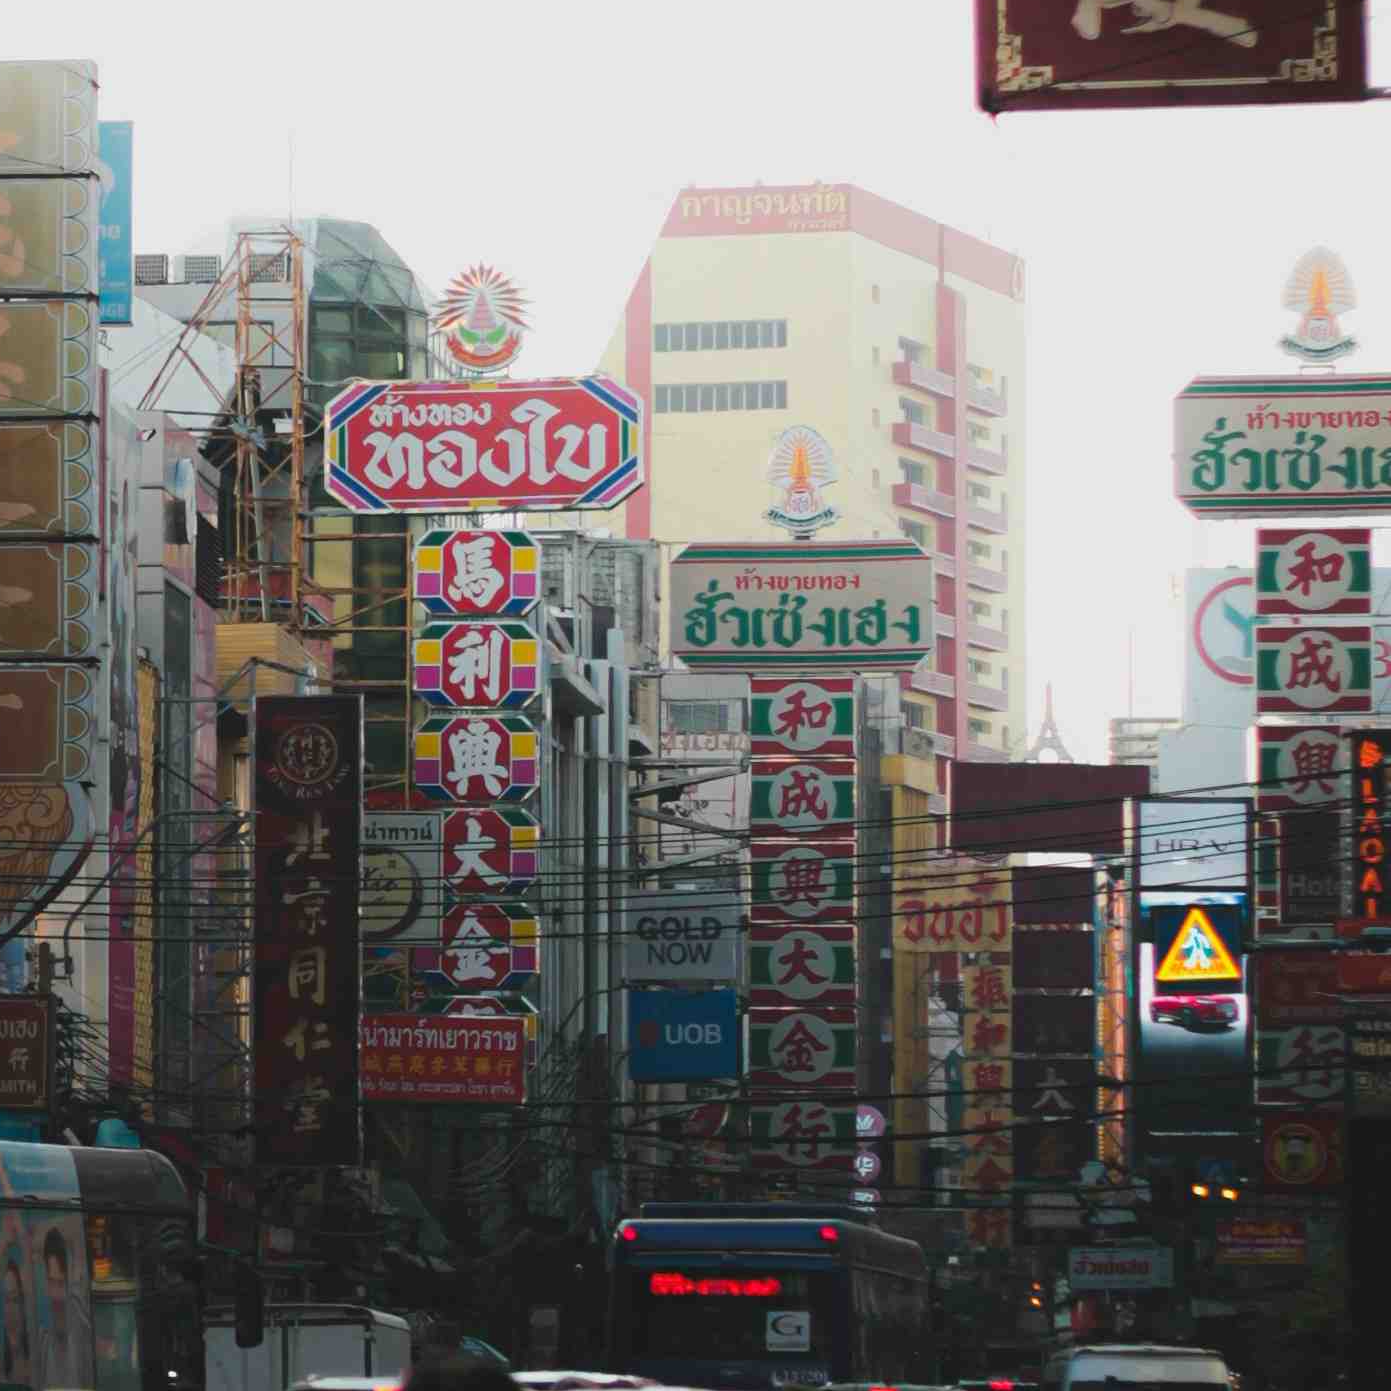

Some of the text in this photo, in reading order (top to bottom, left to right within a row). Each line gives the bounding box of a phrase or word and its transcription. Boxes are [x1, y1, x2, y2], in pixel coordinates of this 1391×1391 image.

[369, 395, 492, 429] ห้างทอง
[363, 398, 609, 492] ทองใบ
[734, 567, 861, 591] ห้างขายทอง
[684, 578, 922, 648] ฮั่วเซ่งเฮง
[445, 539, 510, 1014] 馬利興大金
[636, 914, 722, 942] GOLD
[647, 940, 713, 967] NOW
[664, 1023, 723, 1046] UOB
